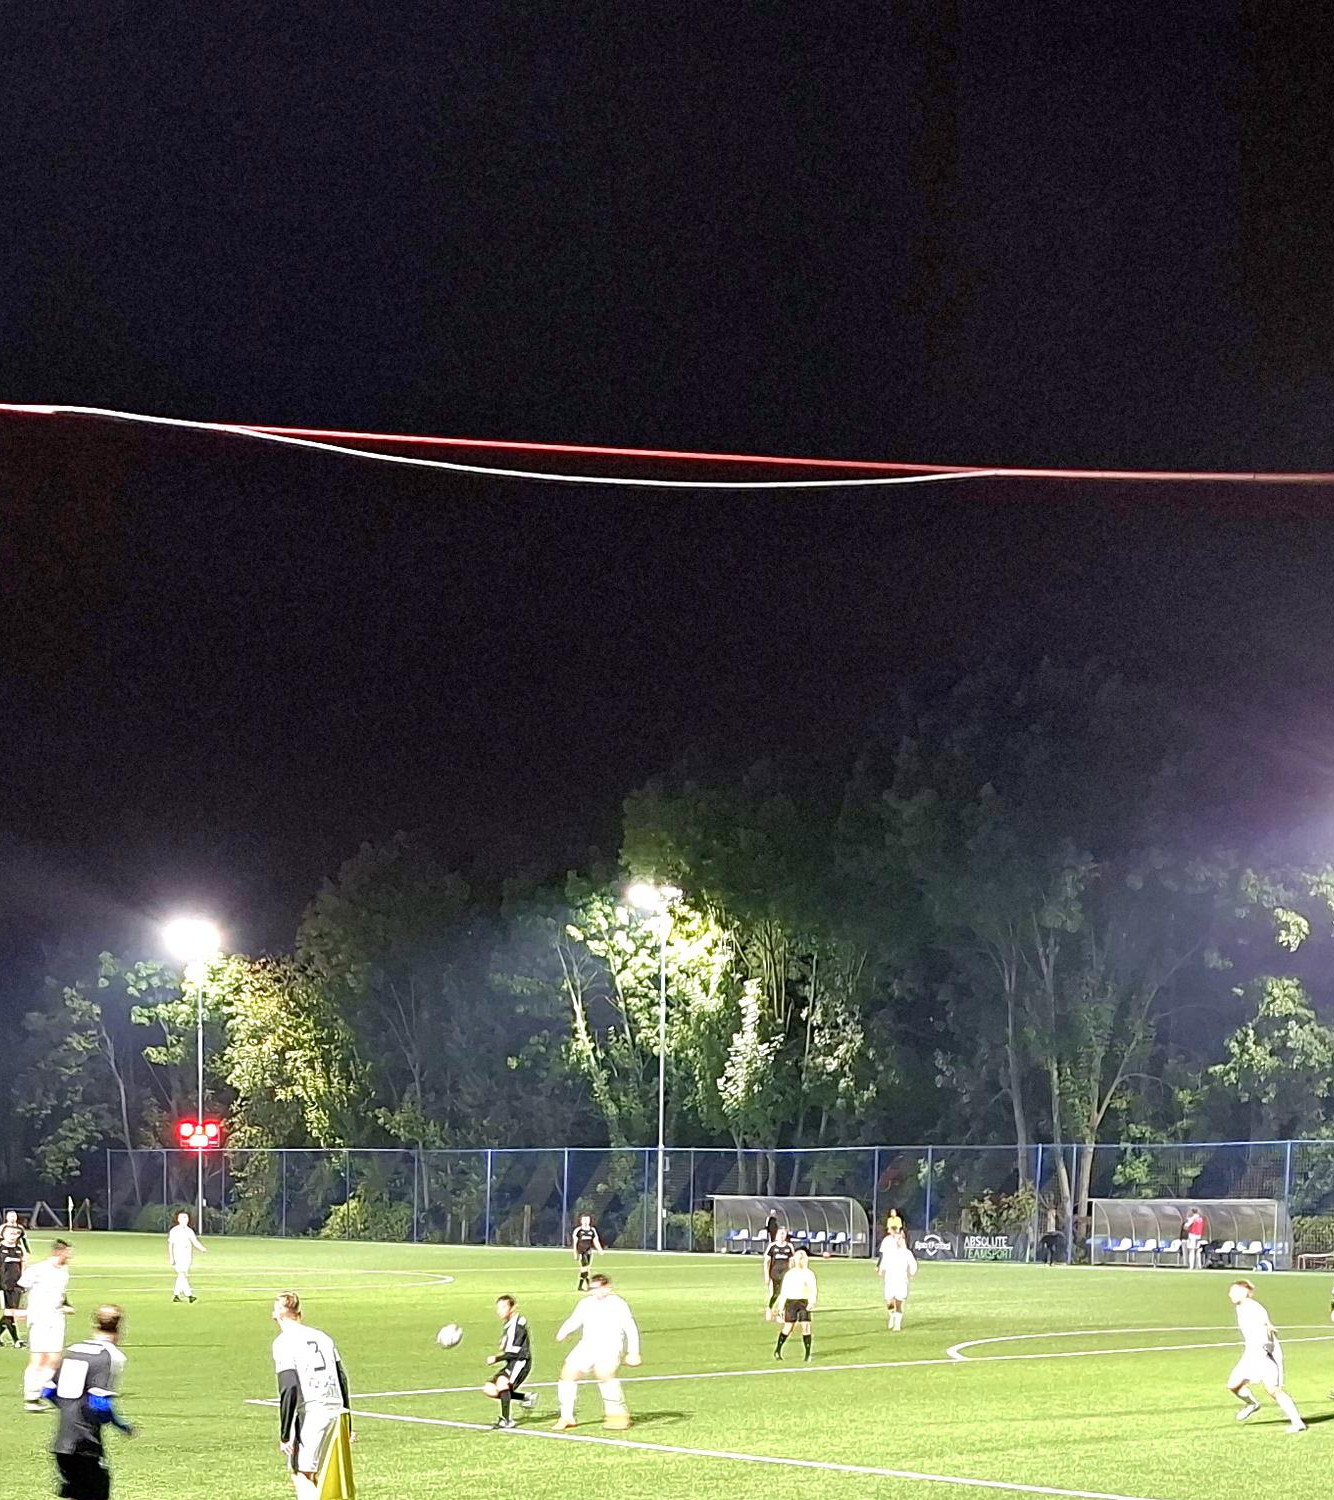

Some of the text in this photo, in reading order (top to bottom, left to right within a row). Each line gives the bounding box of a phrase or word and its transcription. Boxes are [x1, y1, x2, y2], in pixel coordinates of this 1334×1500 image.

[964, 1236, 1009, 1247] ABSOLUTE
[964, 1248, 1013, 1259] TEAMSPORT
[306, 1341, 327, 1372] 3
